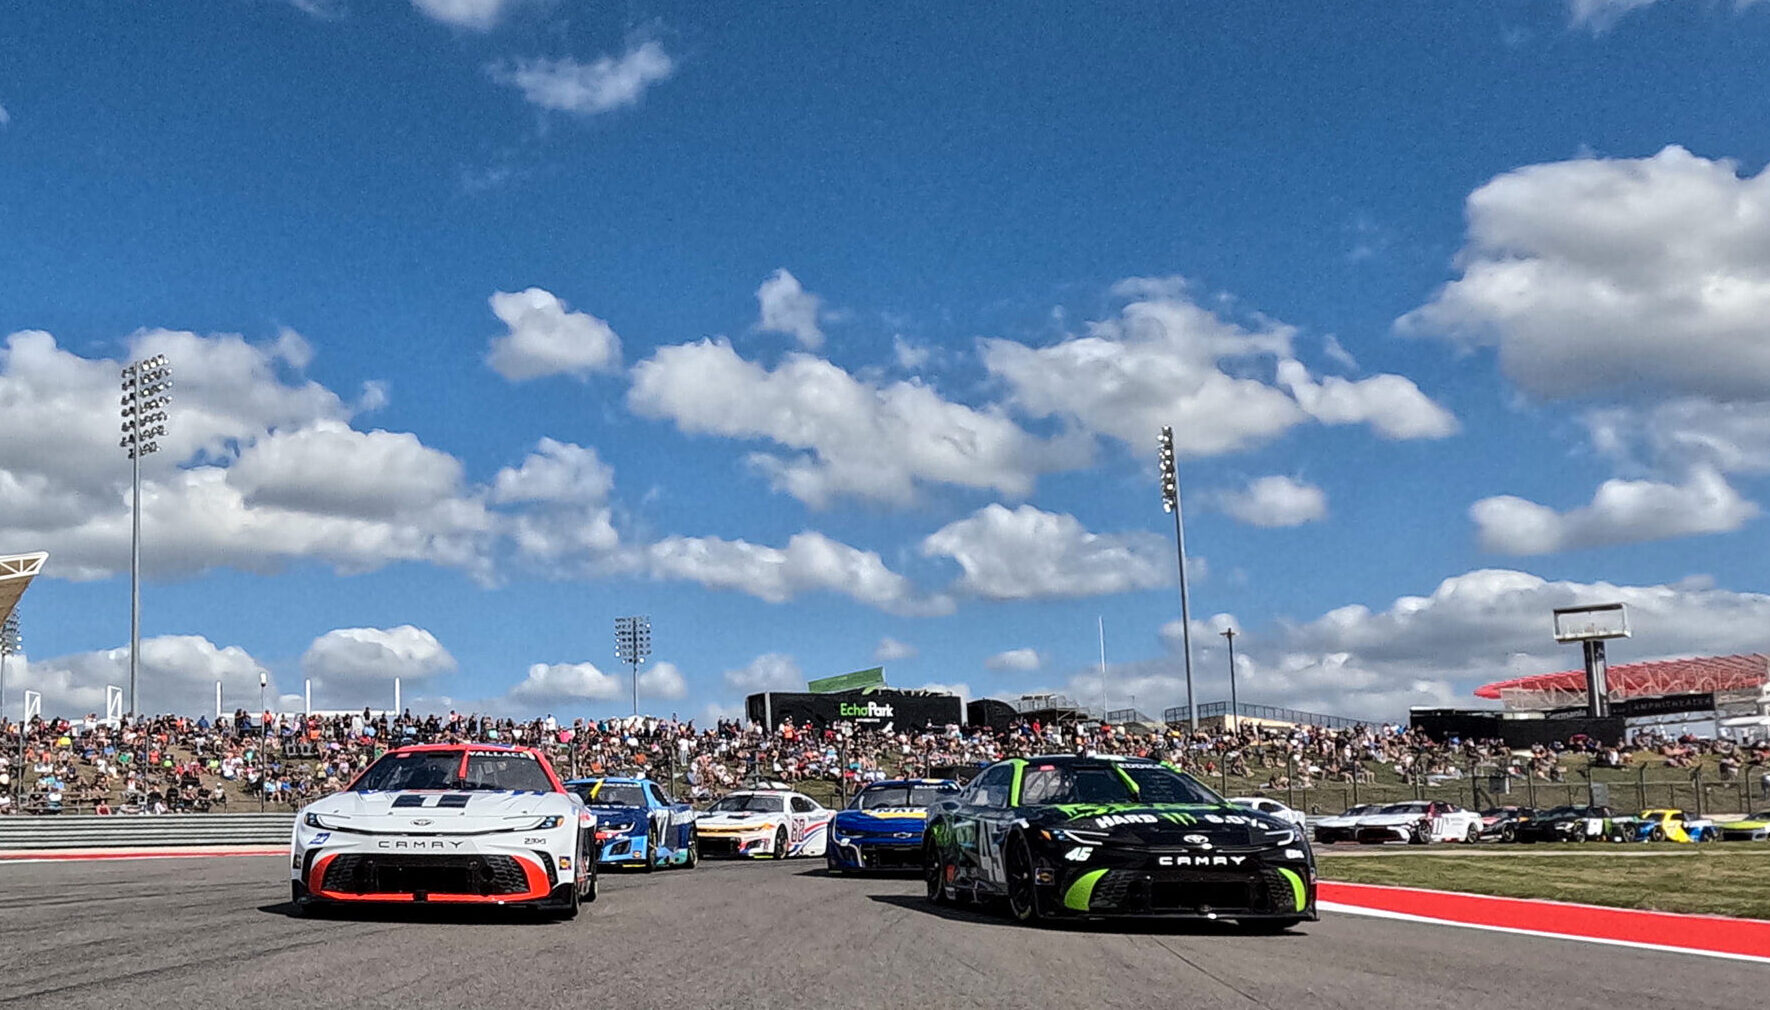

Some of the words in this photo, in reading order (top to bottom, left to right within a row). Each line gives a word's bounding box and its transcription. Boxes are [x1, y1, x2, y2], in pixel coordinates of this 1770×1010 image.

[840, 701, 894, 717] EchoPark
[1095, 814, 1158, 829] HARD
[378, 841, 465, 849] CAMRY
[1158, 856, 1246, 865] CAMRY
